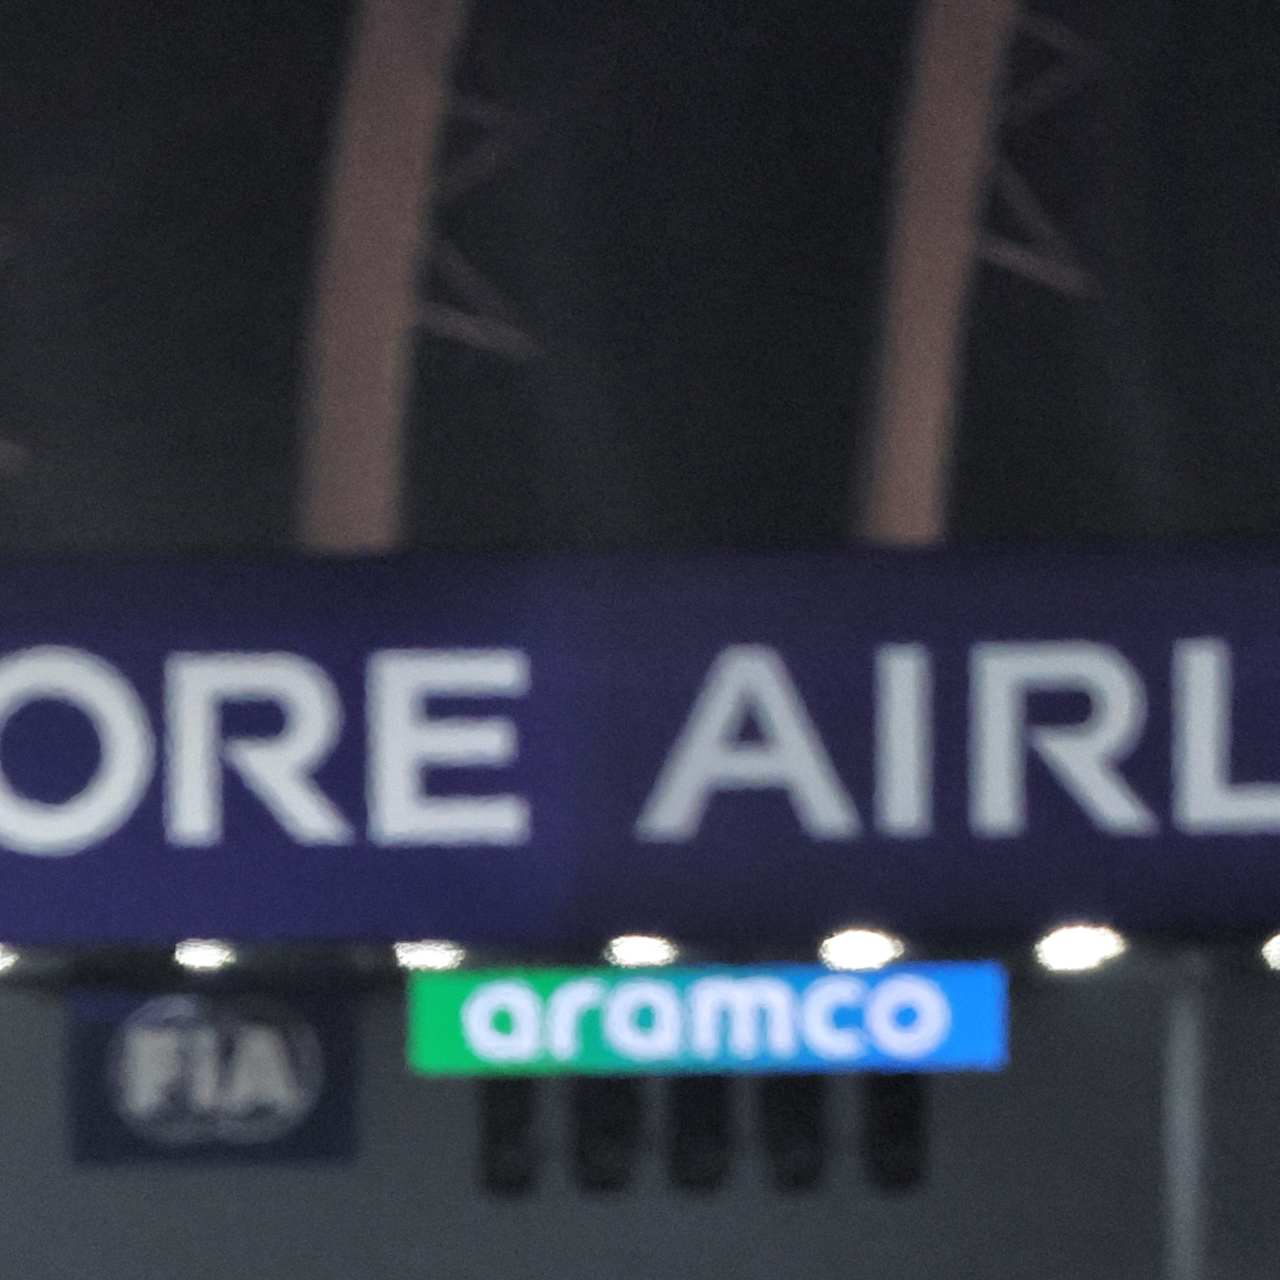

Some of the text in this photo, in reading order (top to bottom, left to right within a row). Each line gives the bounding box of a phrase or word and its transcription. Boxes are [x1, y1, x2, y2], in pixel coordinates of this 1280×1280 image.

[630, 636, 1280, 842] AIRL
[460, 970, 952, 1065] aramco
[125, 1024, 308, 1116] FIA
